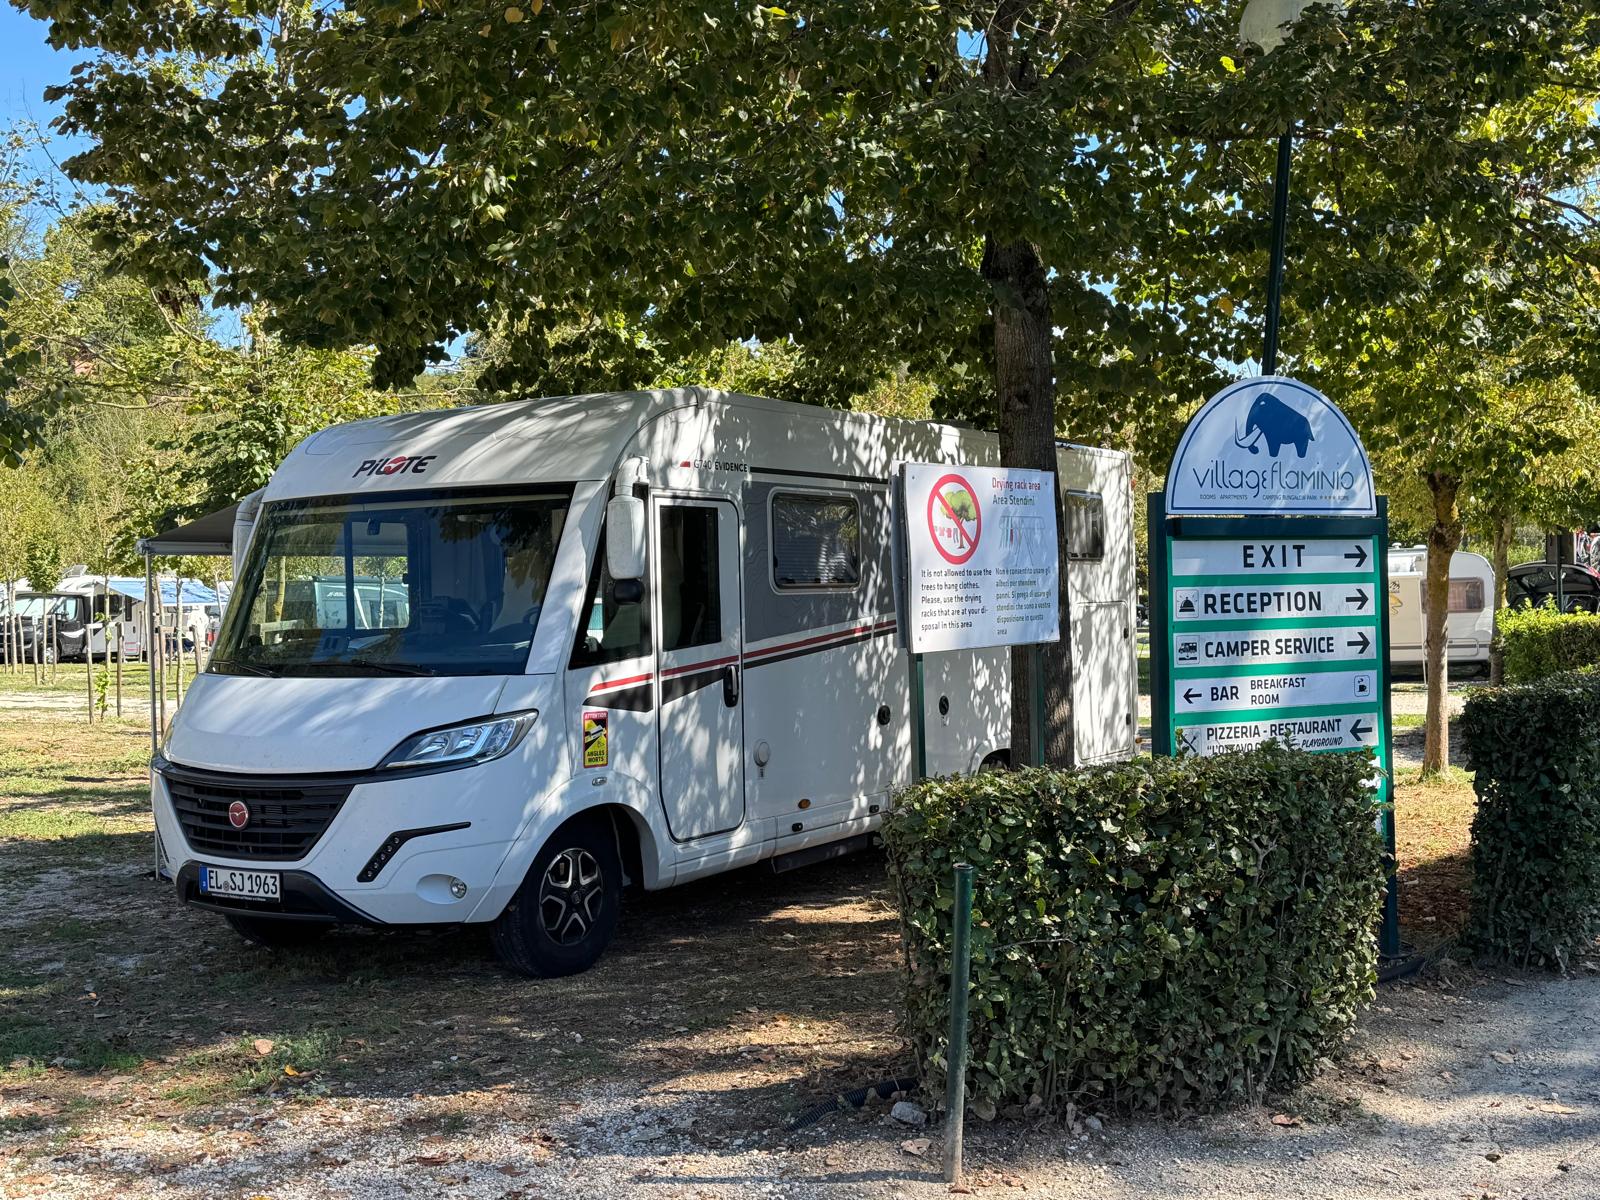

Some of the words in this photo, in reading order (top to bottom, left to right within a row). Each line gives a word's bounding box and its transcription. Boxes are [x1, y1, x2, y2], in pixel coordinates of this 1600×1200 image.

[715, 461, 748, 472] EVIDENCE
[992, 477, 1014, 492] Drying
[1014, 480, 1028, 490] rack
[1028, 482, 1041, 491] area
[992, 494, 1008, 505] Area
[1243, 544, 1306, 568] EXIT
[921, 569, 926, 578] It
[926, 569, 933, 578] is
[933, 569, 943, 577] not
[943, 568, 966, 577] allowed
[966, 569, 973, 577] to
[982, 568, 992, 576] the
[921, 583, 936, 591] trees
[936, 582, 943, 590] to
[944, 581, 959, 592] hang
[954, 594, 964, 603] the
[964, 594, 982, 604] drying
[1204, 591, 1322, 615] RECEPTION
[921, 609, 937, 618] racks
[937, 608, 950, 617] that
[961, 607, 968, 615] at
[967, 608, 980, 617] your
[921, 622, 940, 632] sposal
[941, 621, 948, 629] in
[948, 620, 960, 629] this
[960, 621, 973, 629] area
[1204, 640, 1271, 658] CAMPER
[1275, 636, 1335, 655] SERVICE
[1250, 677, 1307, 691] BREAKFAST
[1210, 685, 1240, 702] BAR
[1250, 693, 1280, 706] ROOM
[1206, 725, 1261, 741] PIZZERIA
[1269, 718, 1342, 737] RESTAURANT
[1301, 736, 1344, 748] PLAYGROUND
[208, 870, 222, 889] EL
